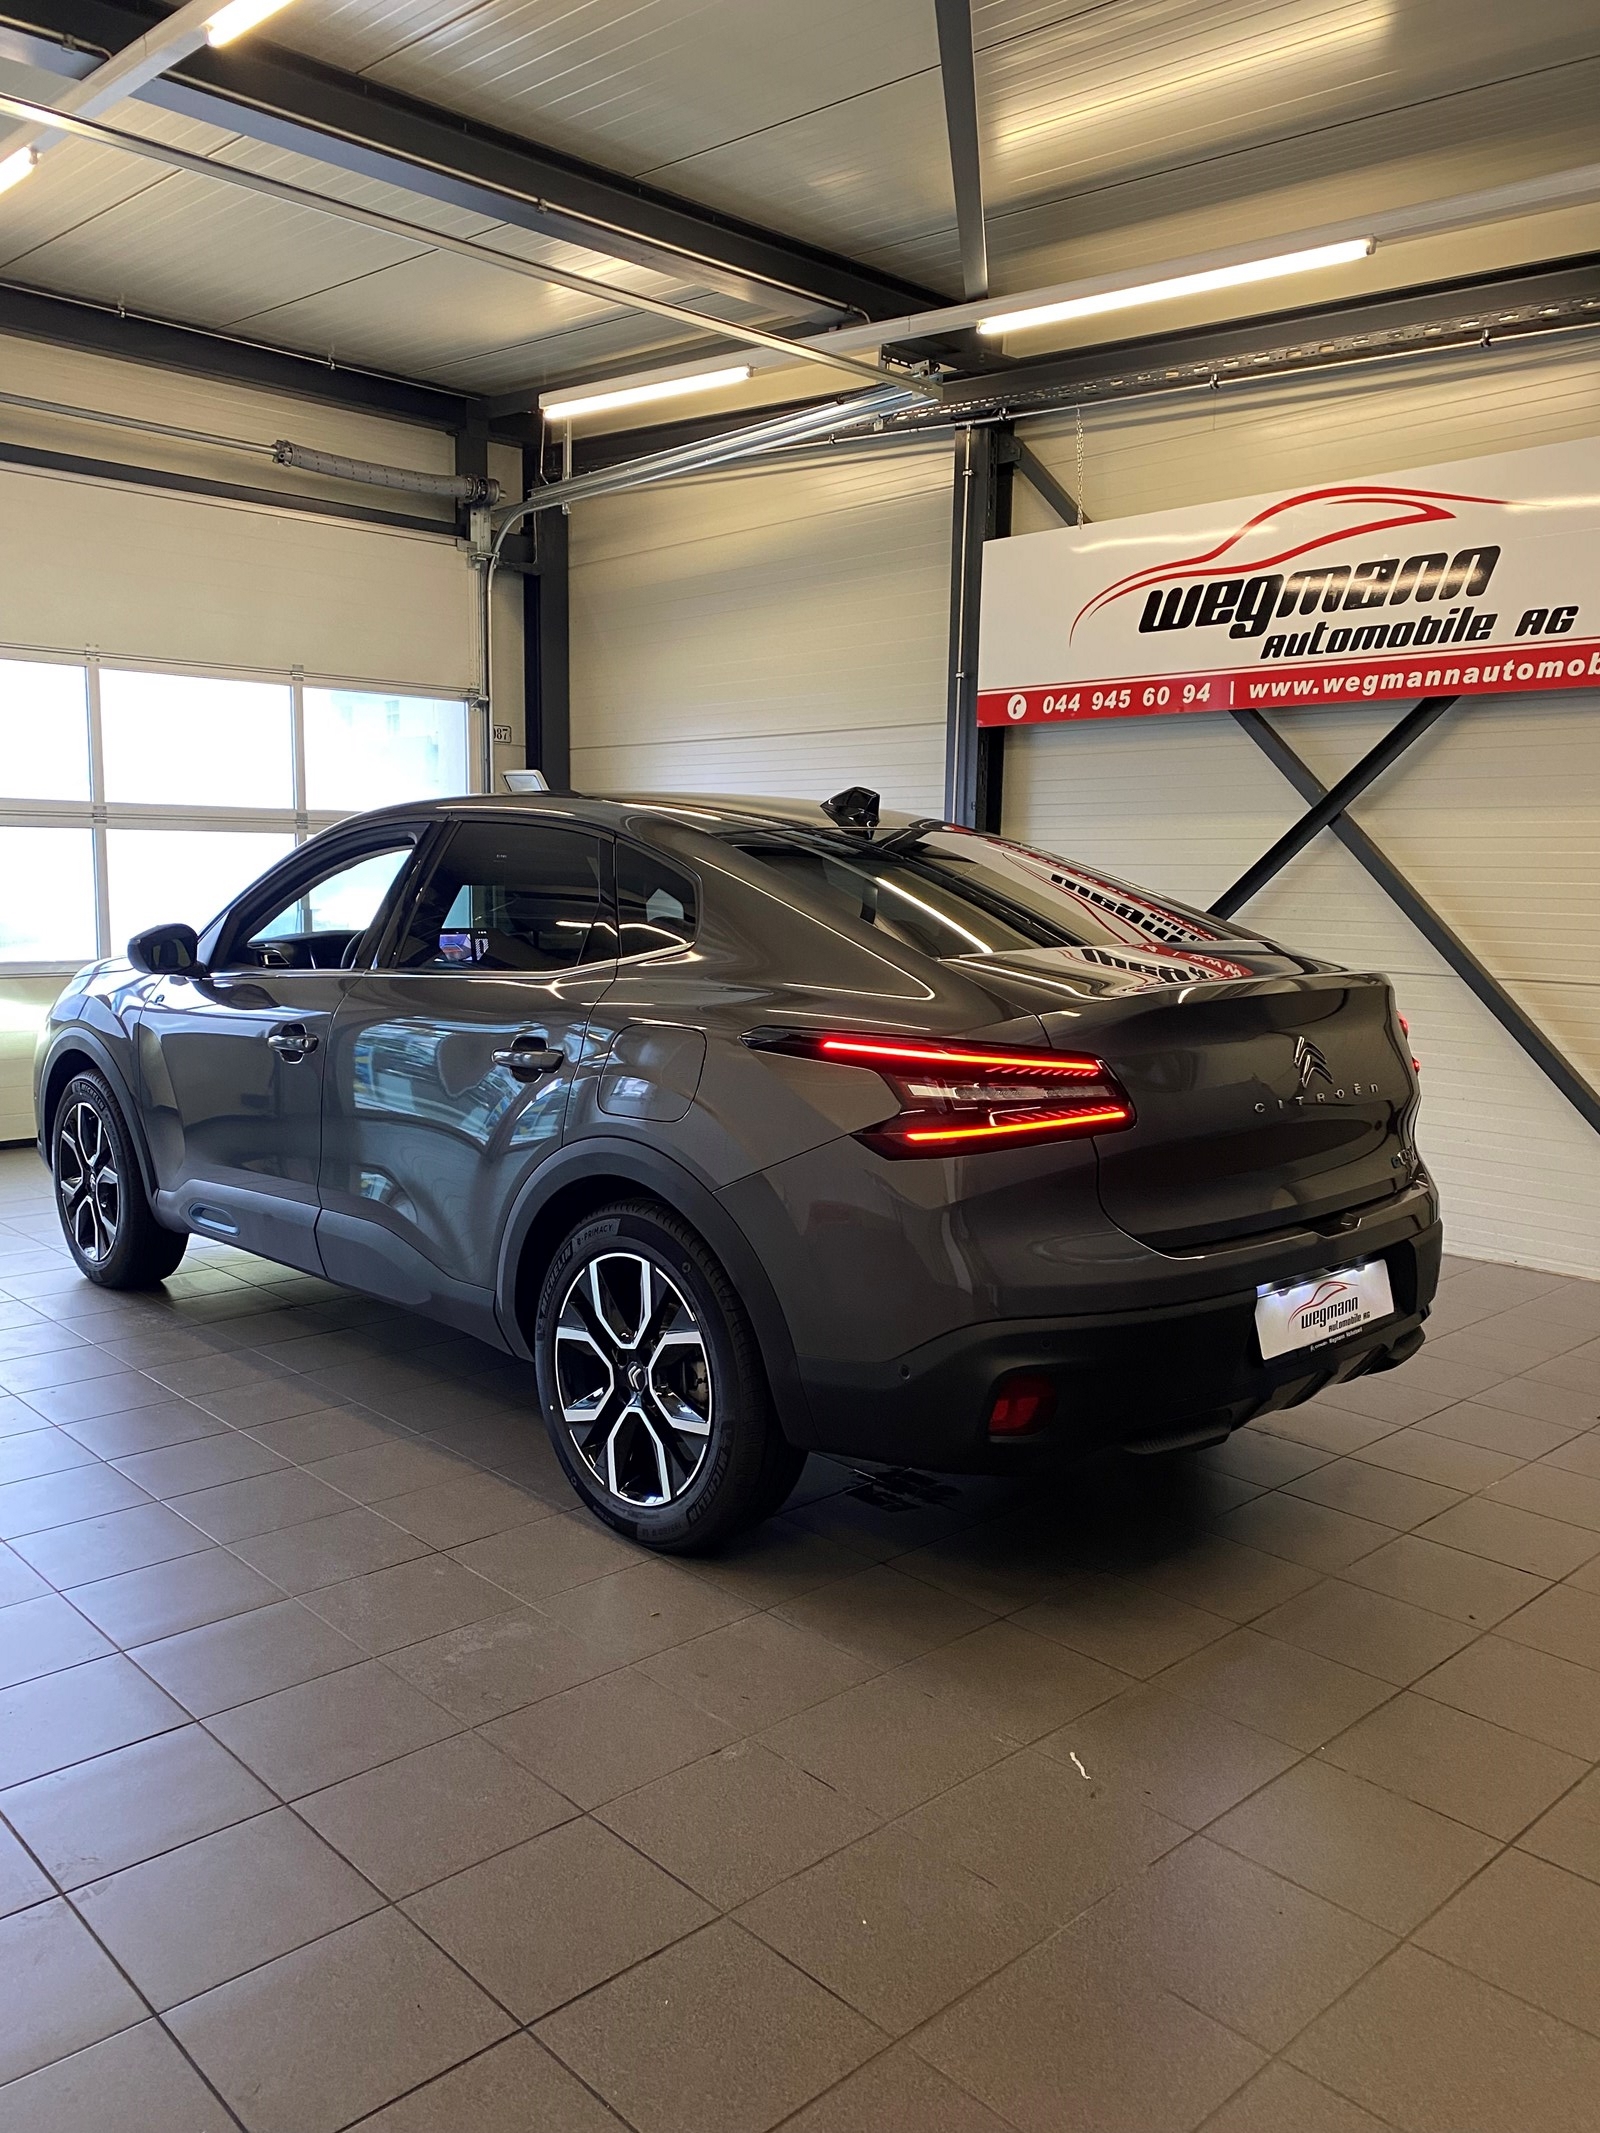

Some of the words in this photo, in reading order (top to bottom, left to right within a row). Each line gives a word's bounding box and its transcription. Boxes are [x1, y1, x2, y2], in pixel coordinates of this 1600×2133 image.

[1138, 545, 1501, 640] wegmann
[1515, 605, 1579, 636] AG
[1042, 693, 1081, 714] 044
[1091, 689, 1132, 711] 945
[1142, 686, 1171, 707] 60
[1182, 682, 1212, 703] 94
[541, 1244, 572, 1315] MICHELIN
[1302, 1297, 1358, 1329] wegmann
